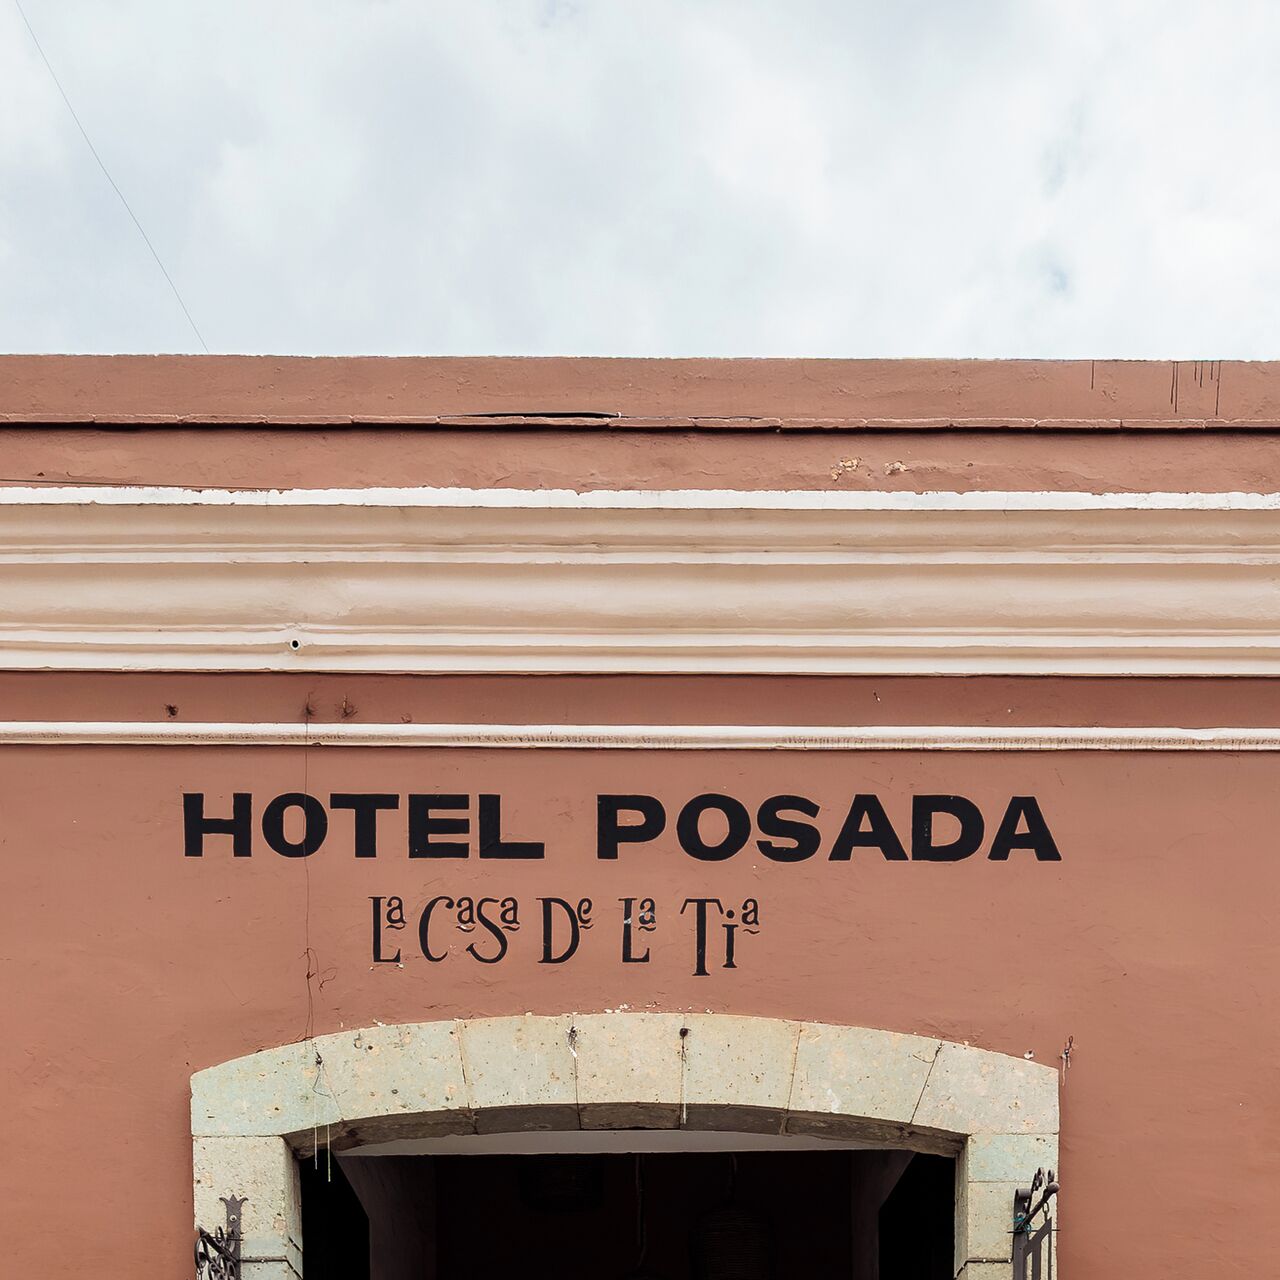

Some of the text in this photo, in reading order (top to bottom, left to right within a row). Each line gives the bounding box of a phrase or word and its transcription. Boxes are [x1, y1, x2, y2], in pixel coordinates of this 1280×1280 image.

[182, 793, 1062, 863] HOTEL POSADA
[368, 896, 407, 963] La
[537, 897, 593, 963] De
[619, 897, 656, 962] La
